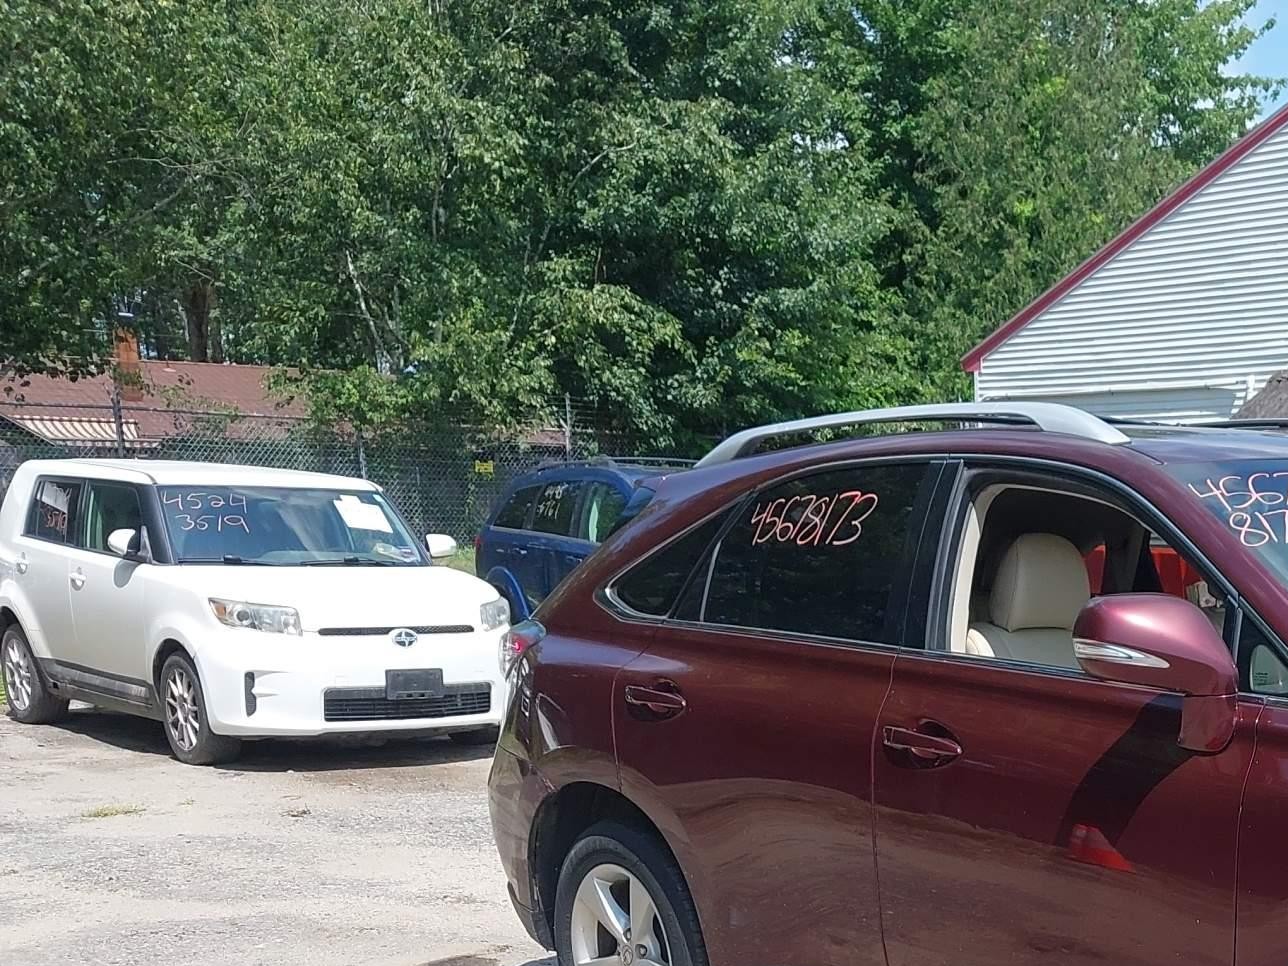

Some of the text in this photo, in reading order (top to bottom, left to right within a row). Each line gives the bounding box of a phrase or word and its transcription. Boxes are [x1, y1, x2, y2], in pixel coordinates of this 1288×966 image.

[163, 490, 247, 514] 4524
[175, 513, 249, 534] 3519
[751, 491, 878, 546] 45678173
